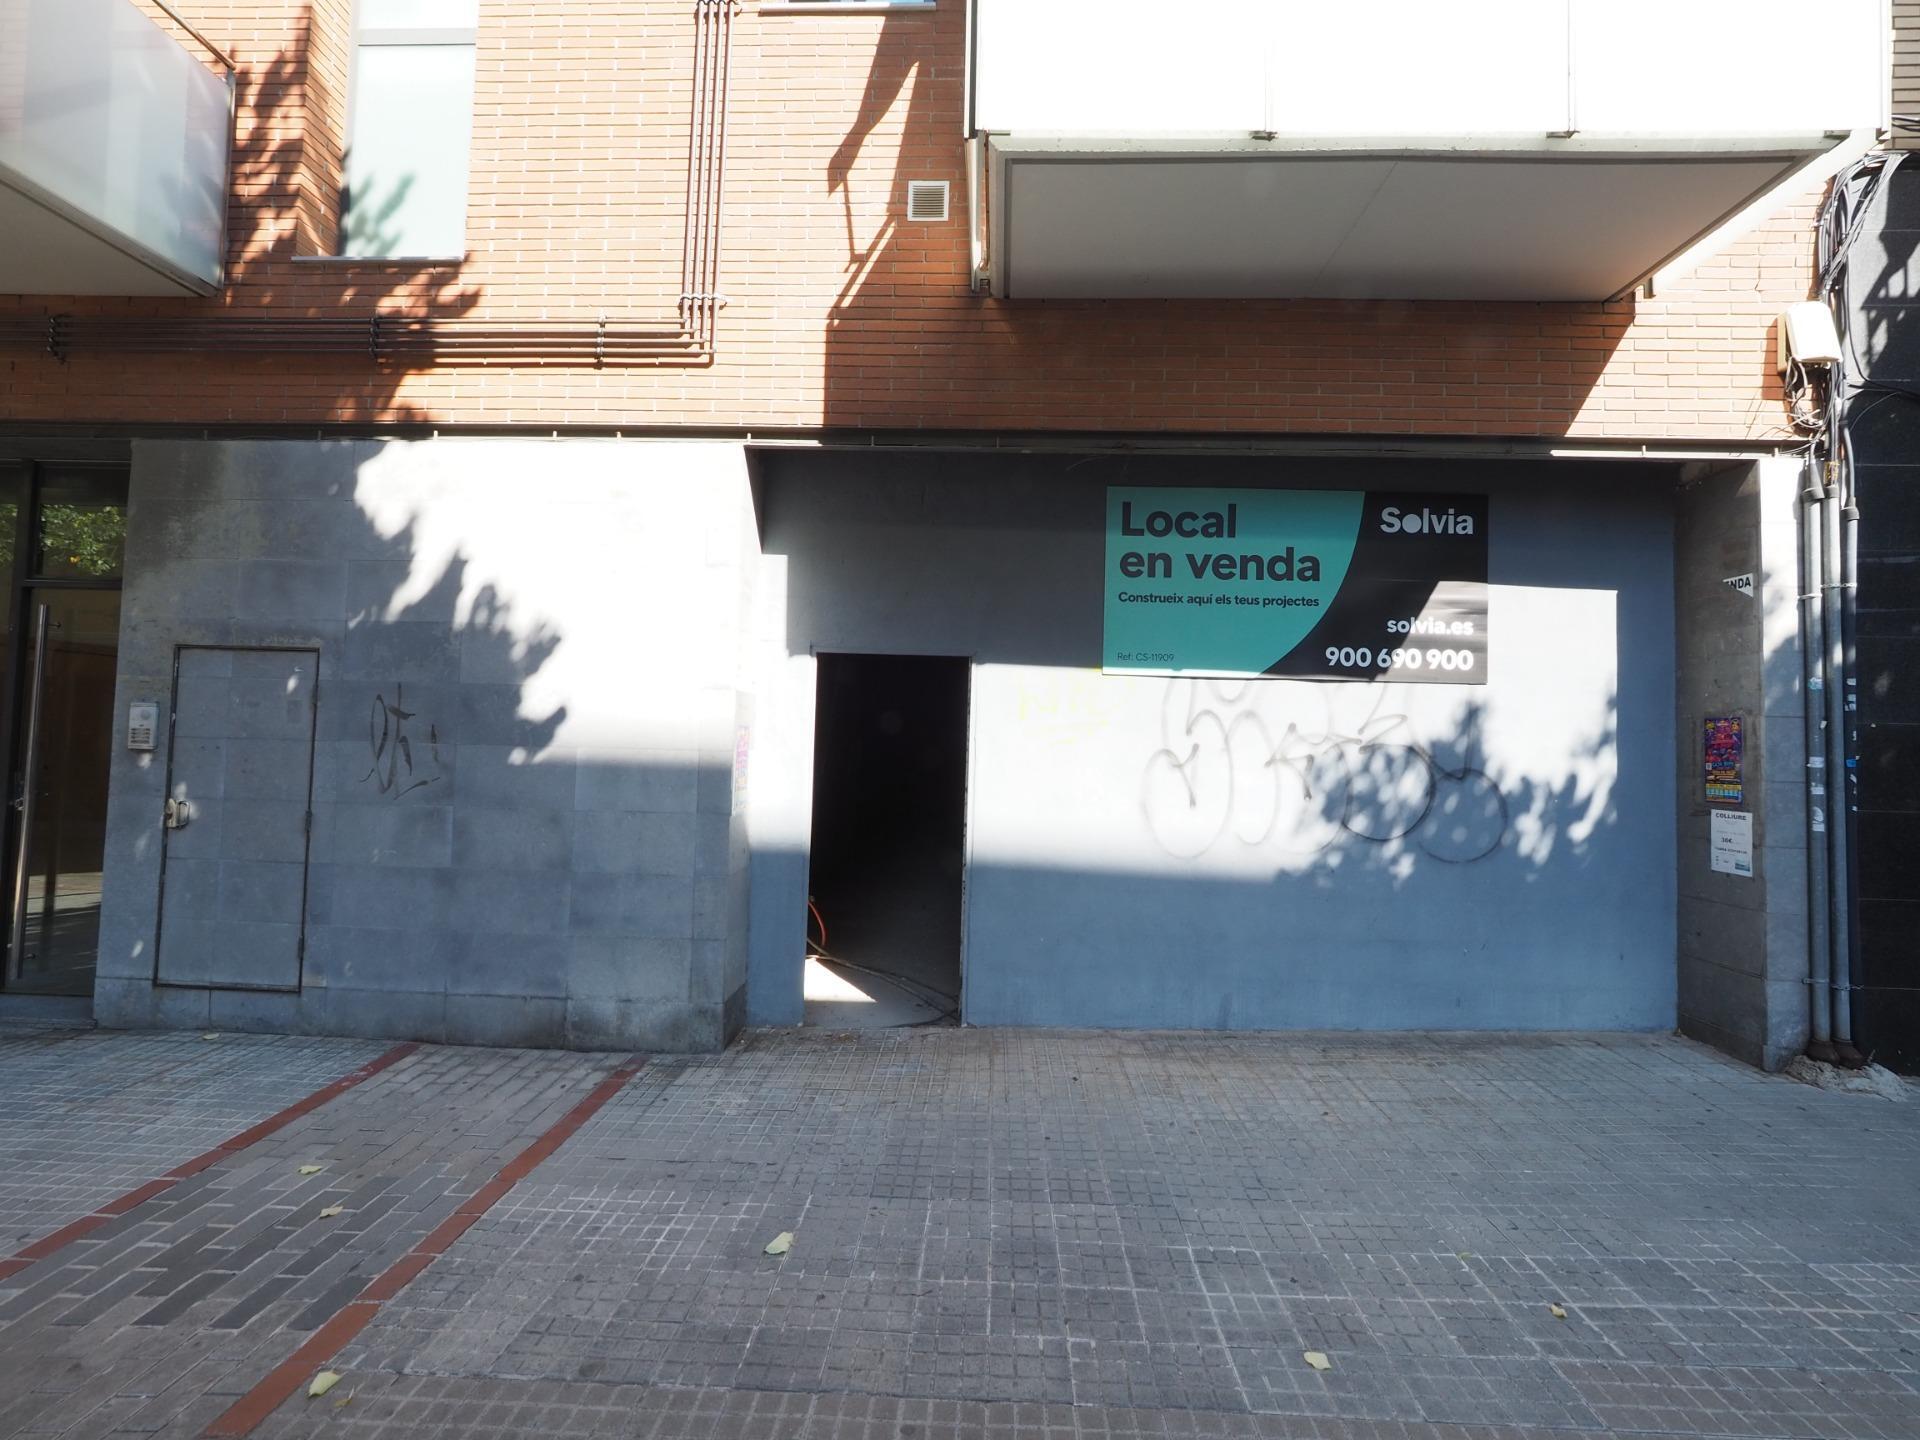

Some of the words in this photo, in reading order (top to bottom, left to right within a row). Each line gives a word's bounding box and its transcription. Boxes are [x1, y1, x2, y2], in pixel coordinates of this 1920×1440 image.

[1121, 501, 1237, 538] Local
[1380, 506, 1474, 535] Solvia
[1119, 551, 1172, 579] en
[1185, 546, 1320, 582] venda
[1726, 576, 1751, 589] NDA
[1118, 592, 1183, 604] Construeix
[1187, 594, 1213, 607] aquí
[1215, 595, 1231, 605] els
[1235, 595, 1259, 606] teus
[1262, 596, 1320, 608] projectes
[1387, 617, 1474, 635] solvia.es
[1325, 647, 1372, 668] 900
[1377, 648, 1422, 669] 690
[1426, 649, 1474, 671] 900
